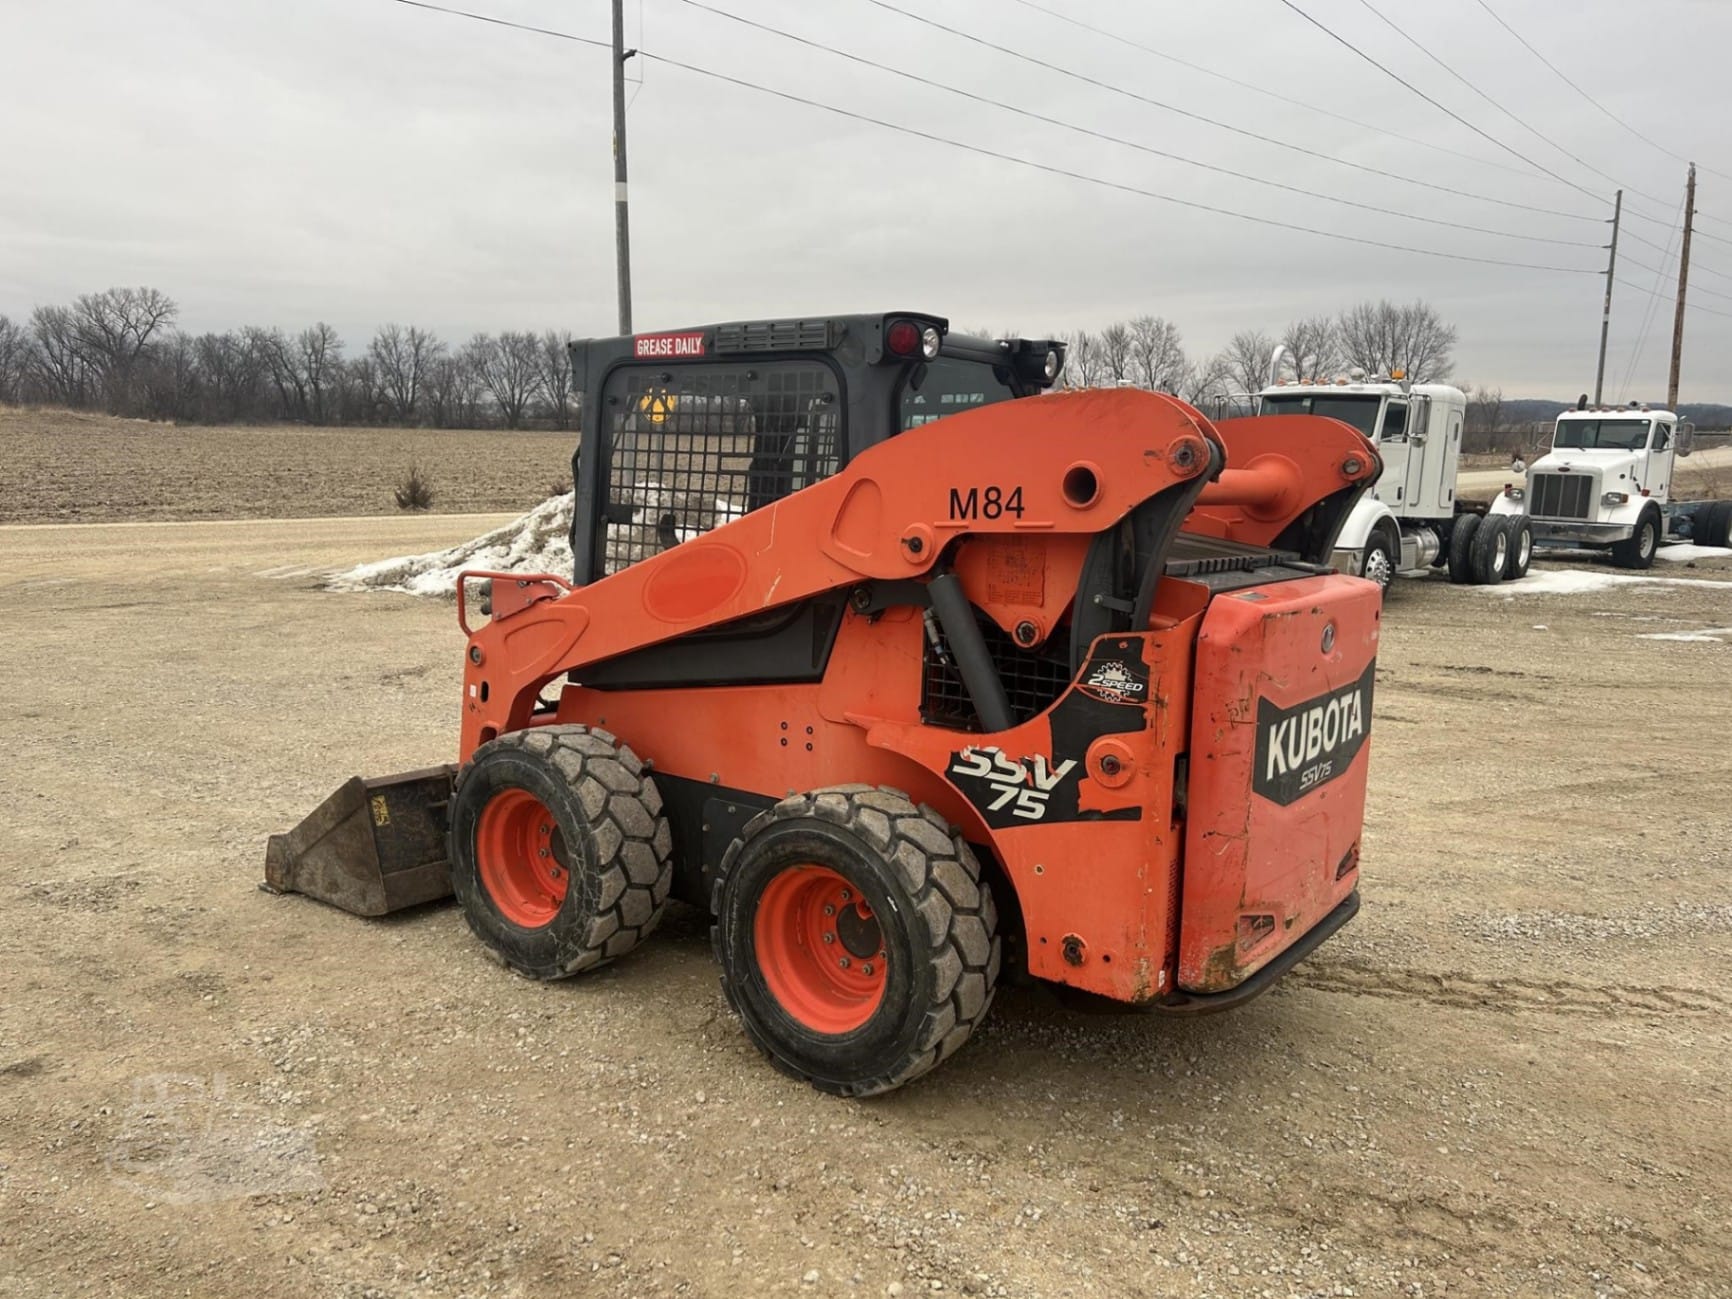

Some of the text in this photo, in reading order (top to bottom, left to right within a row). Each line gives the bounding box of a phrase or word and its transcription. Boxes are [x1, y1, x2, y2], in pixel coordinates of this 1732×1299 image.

[637, 336, 702, 355] GREASE DAILY
[950, 485, 1025, 520] M84
[1266, 689, 1362, 782] KUBOTA
[952, 745, 1078, 791] SSV
[986, 783, 1050, 820] 75
